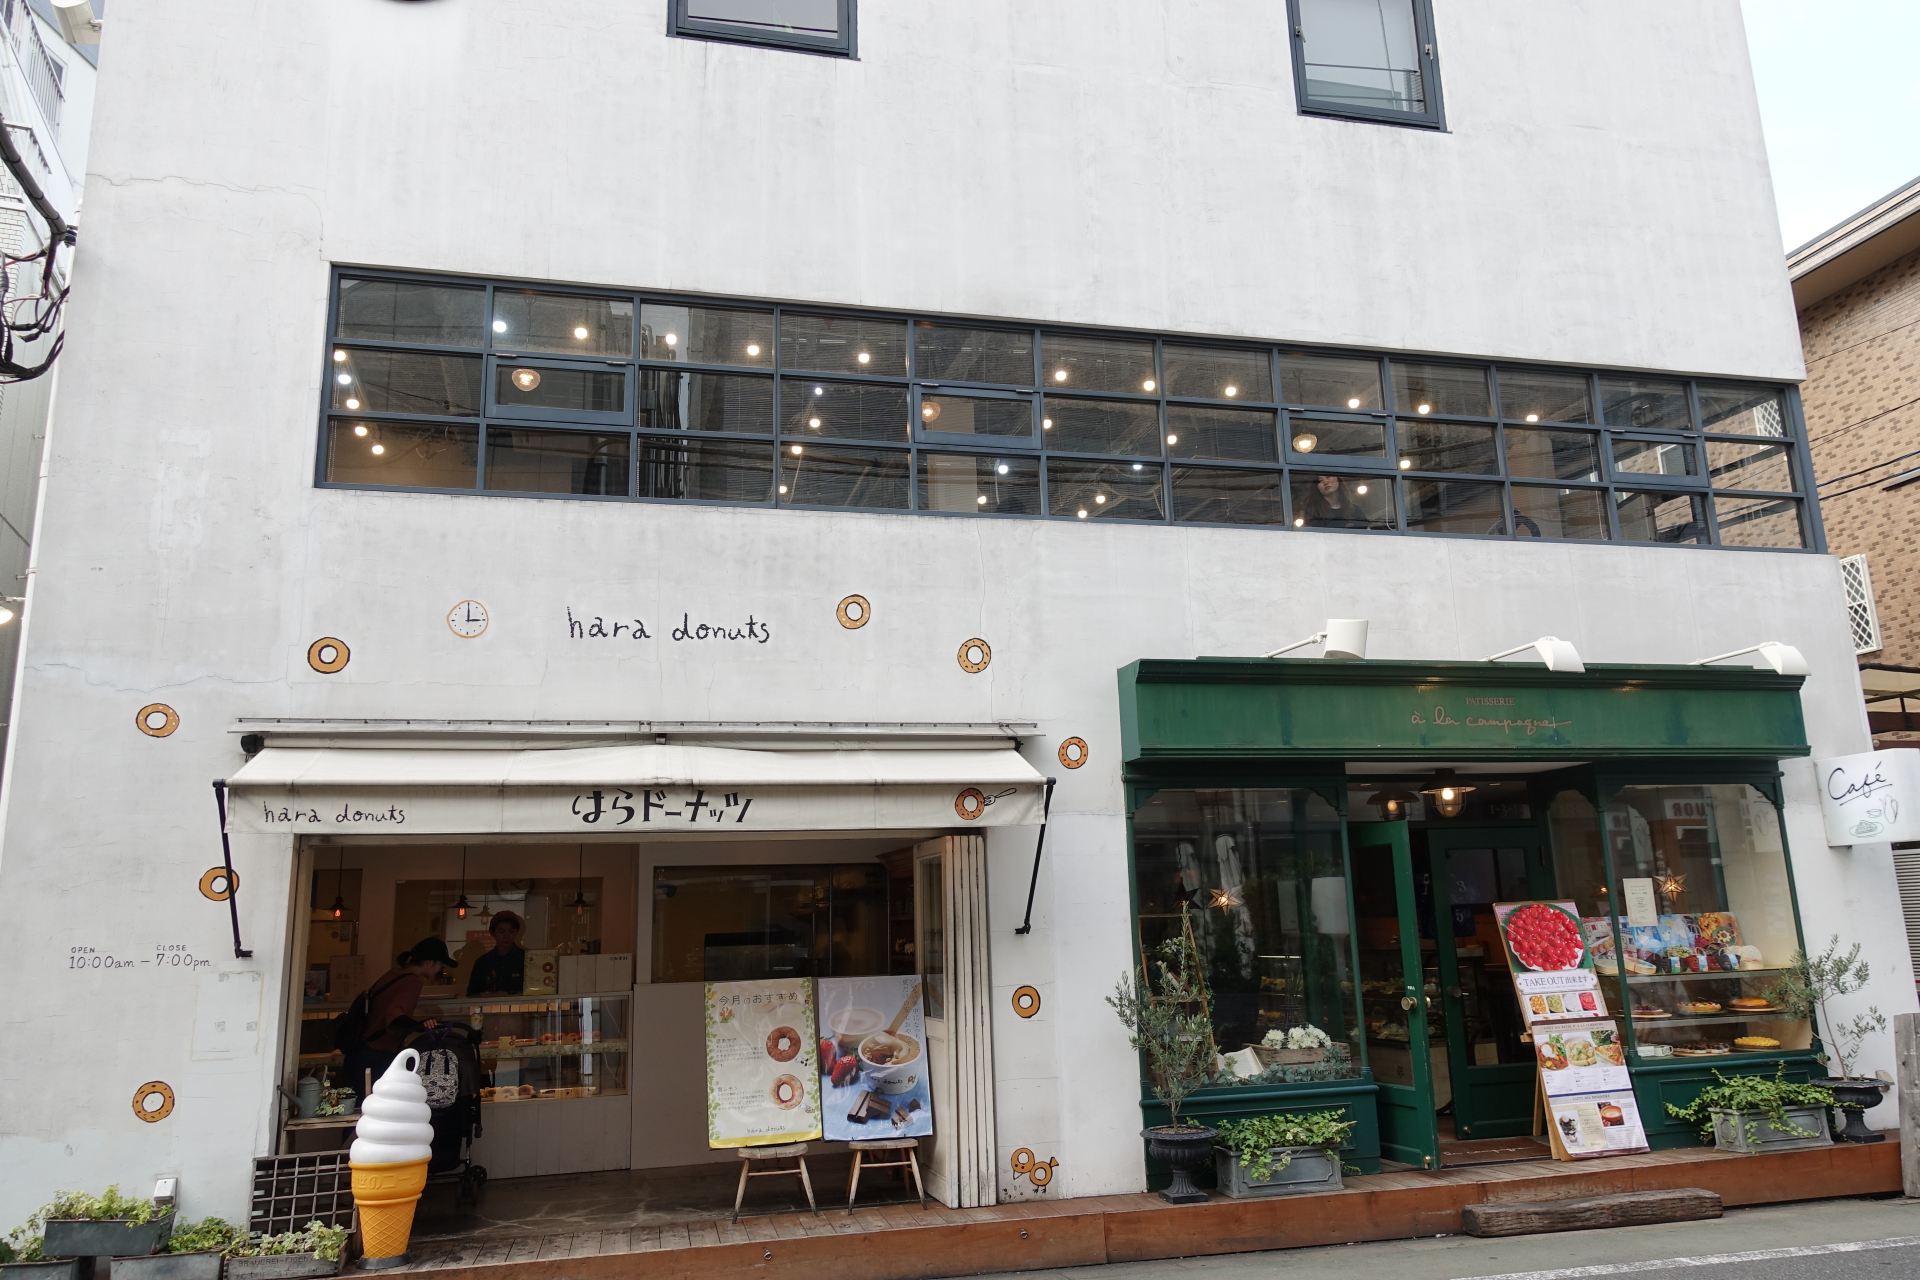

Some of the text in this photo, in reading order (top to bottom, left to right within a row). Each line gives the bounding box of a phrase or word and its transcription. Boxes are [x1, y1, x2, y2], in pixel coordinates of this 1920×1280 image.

[567, 606, 770, 644] hara donuts
[1433, 706, 1460, 725] la
[1827, 761, 1888, 801] Café
[264, 800, 406, 825] hara donuts
[571, 788, 754, 826] はらドーナッツ
[70, 946, 96, 954] OPEN
[156, 944, 187, 952] CLOSE
[69, 954, 135, 969] 10:00am
[156, 953, 211, 971] 7:00pm
[1522, 977, 1547, 987] TAKE
[1546, 976, 1565, 985] OUT
